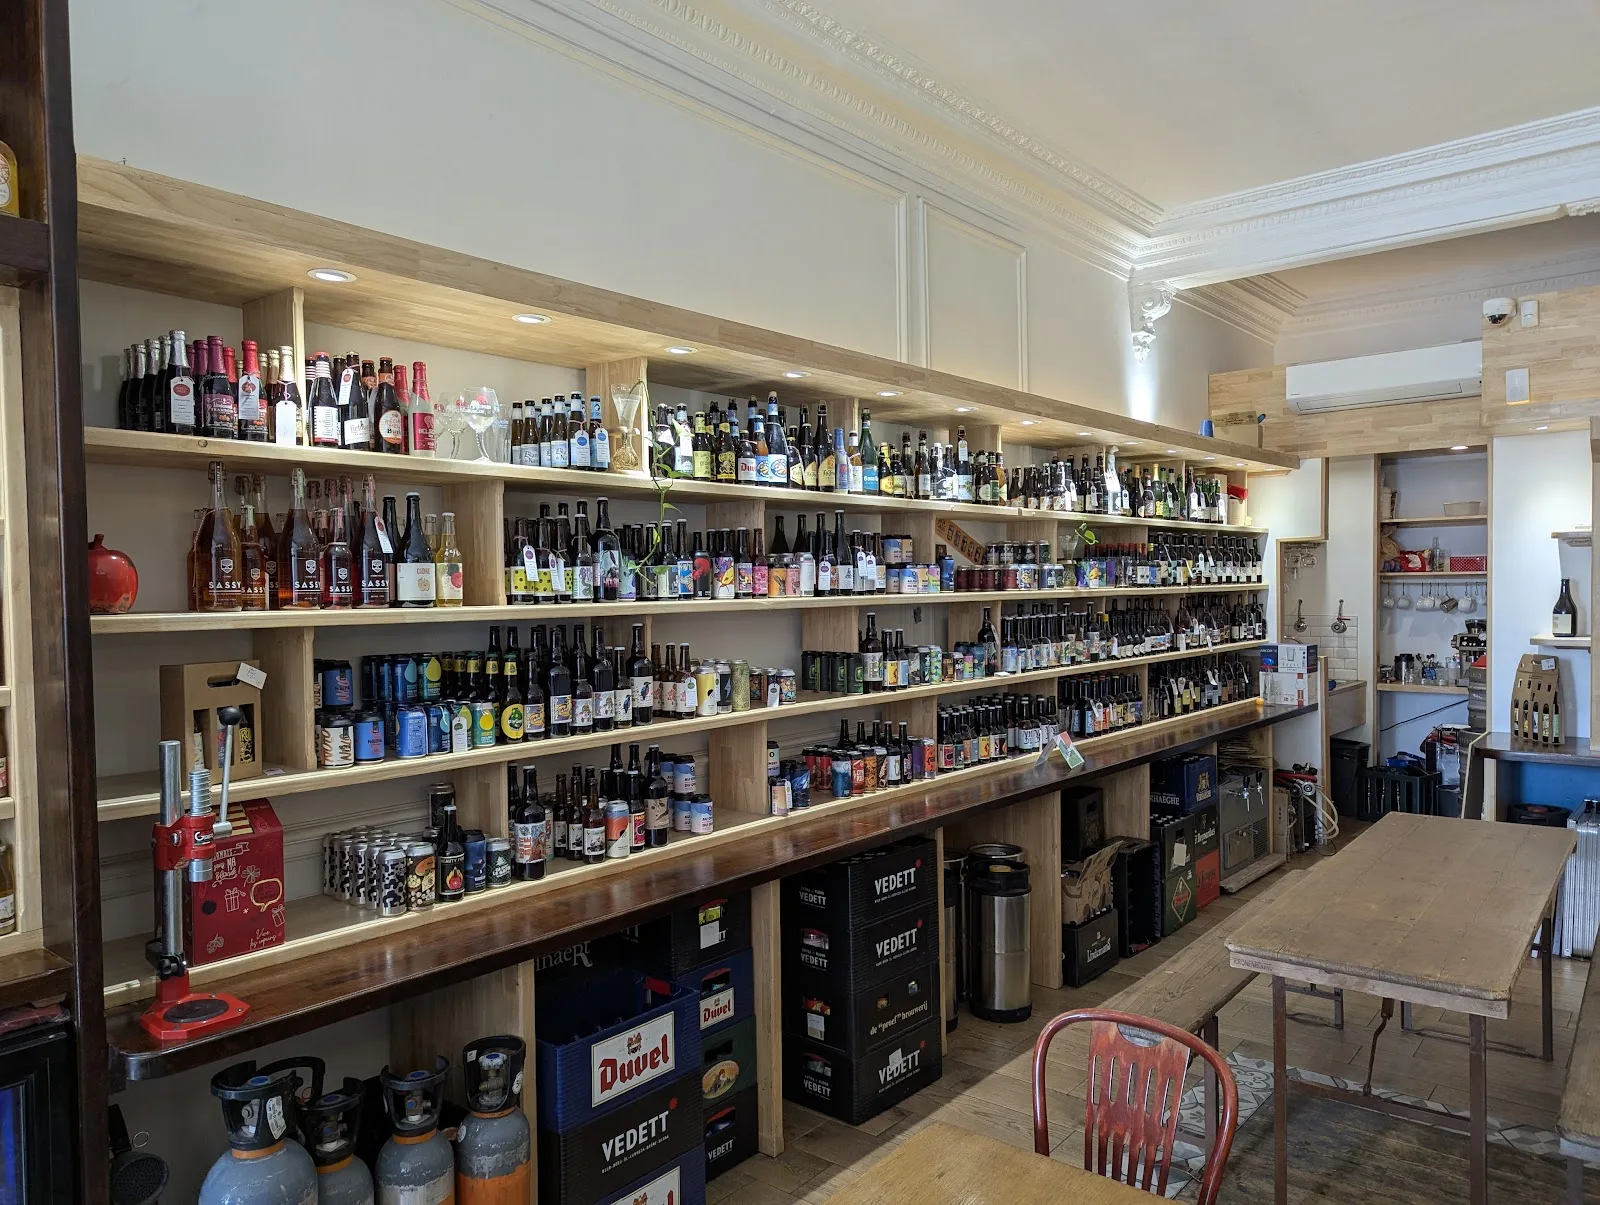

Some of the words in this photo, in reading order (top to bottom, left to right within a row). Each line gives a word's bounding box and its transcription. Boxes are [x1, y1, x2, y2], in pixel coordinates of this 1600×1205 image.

[874, 867, 916, 896] VEDETT
[799, 890, 827, 906] VEDETT
[875, 927, 918, 959] VEDETT
[800, 952, 828, 968] VEDETT
[703, 998, 731, 1023] Duvel
[869, 1026, 878, 1036] de
[901, 1000, 928, 1020] brouwerij
[599, 1033, 670, 1095] Duvel
[878, 1049, 921, 1085] VEDETT
[803, 1078, 832, 1097] VEDETT
[601, 1110, 669, 1162] VEDETT
[707, 1138, 734, 1161] VEDETT
